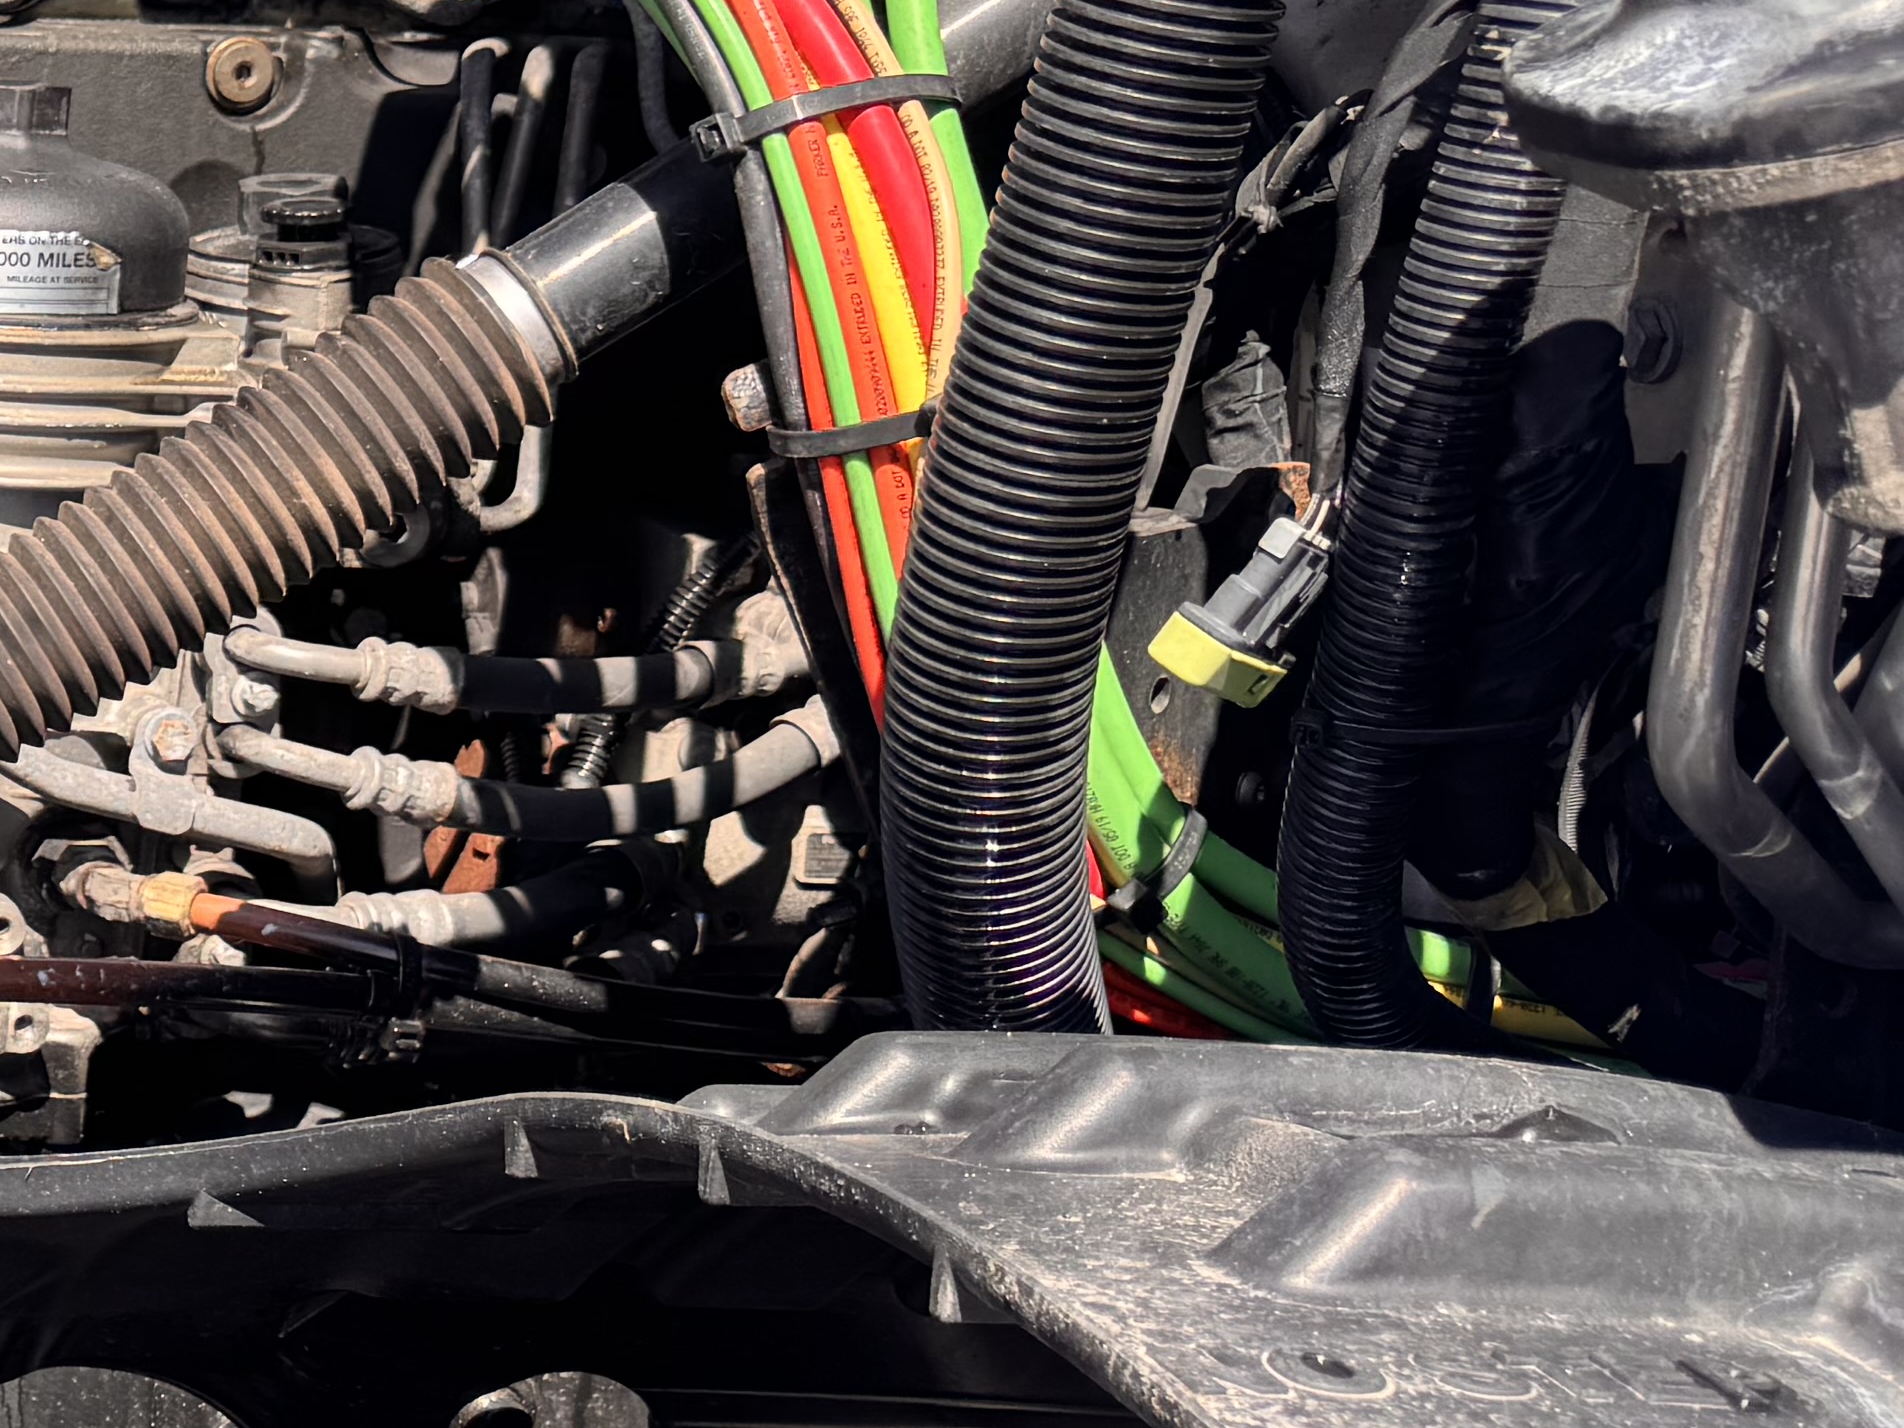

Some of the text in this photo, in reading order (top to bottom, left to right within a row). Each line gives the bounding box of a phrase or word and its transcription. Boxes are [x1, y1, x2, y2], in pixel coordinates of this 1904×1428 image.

[28, 235, 46, 245] ON
[49, 235, 71, 246] THE
[37, 252, 97, 269] MILES
[7, 275, 46, 285] MILEAGE
[49, 276, 61, 285] AT
[63, 276, 99, 285] SERVICE
